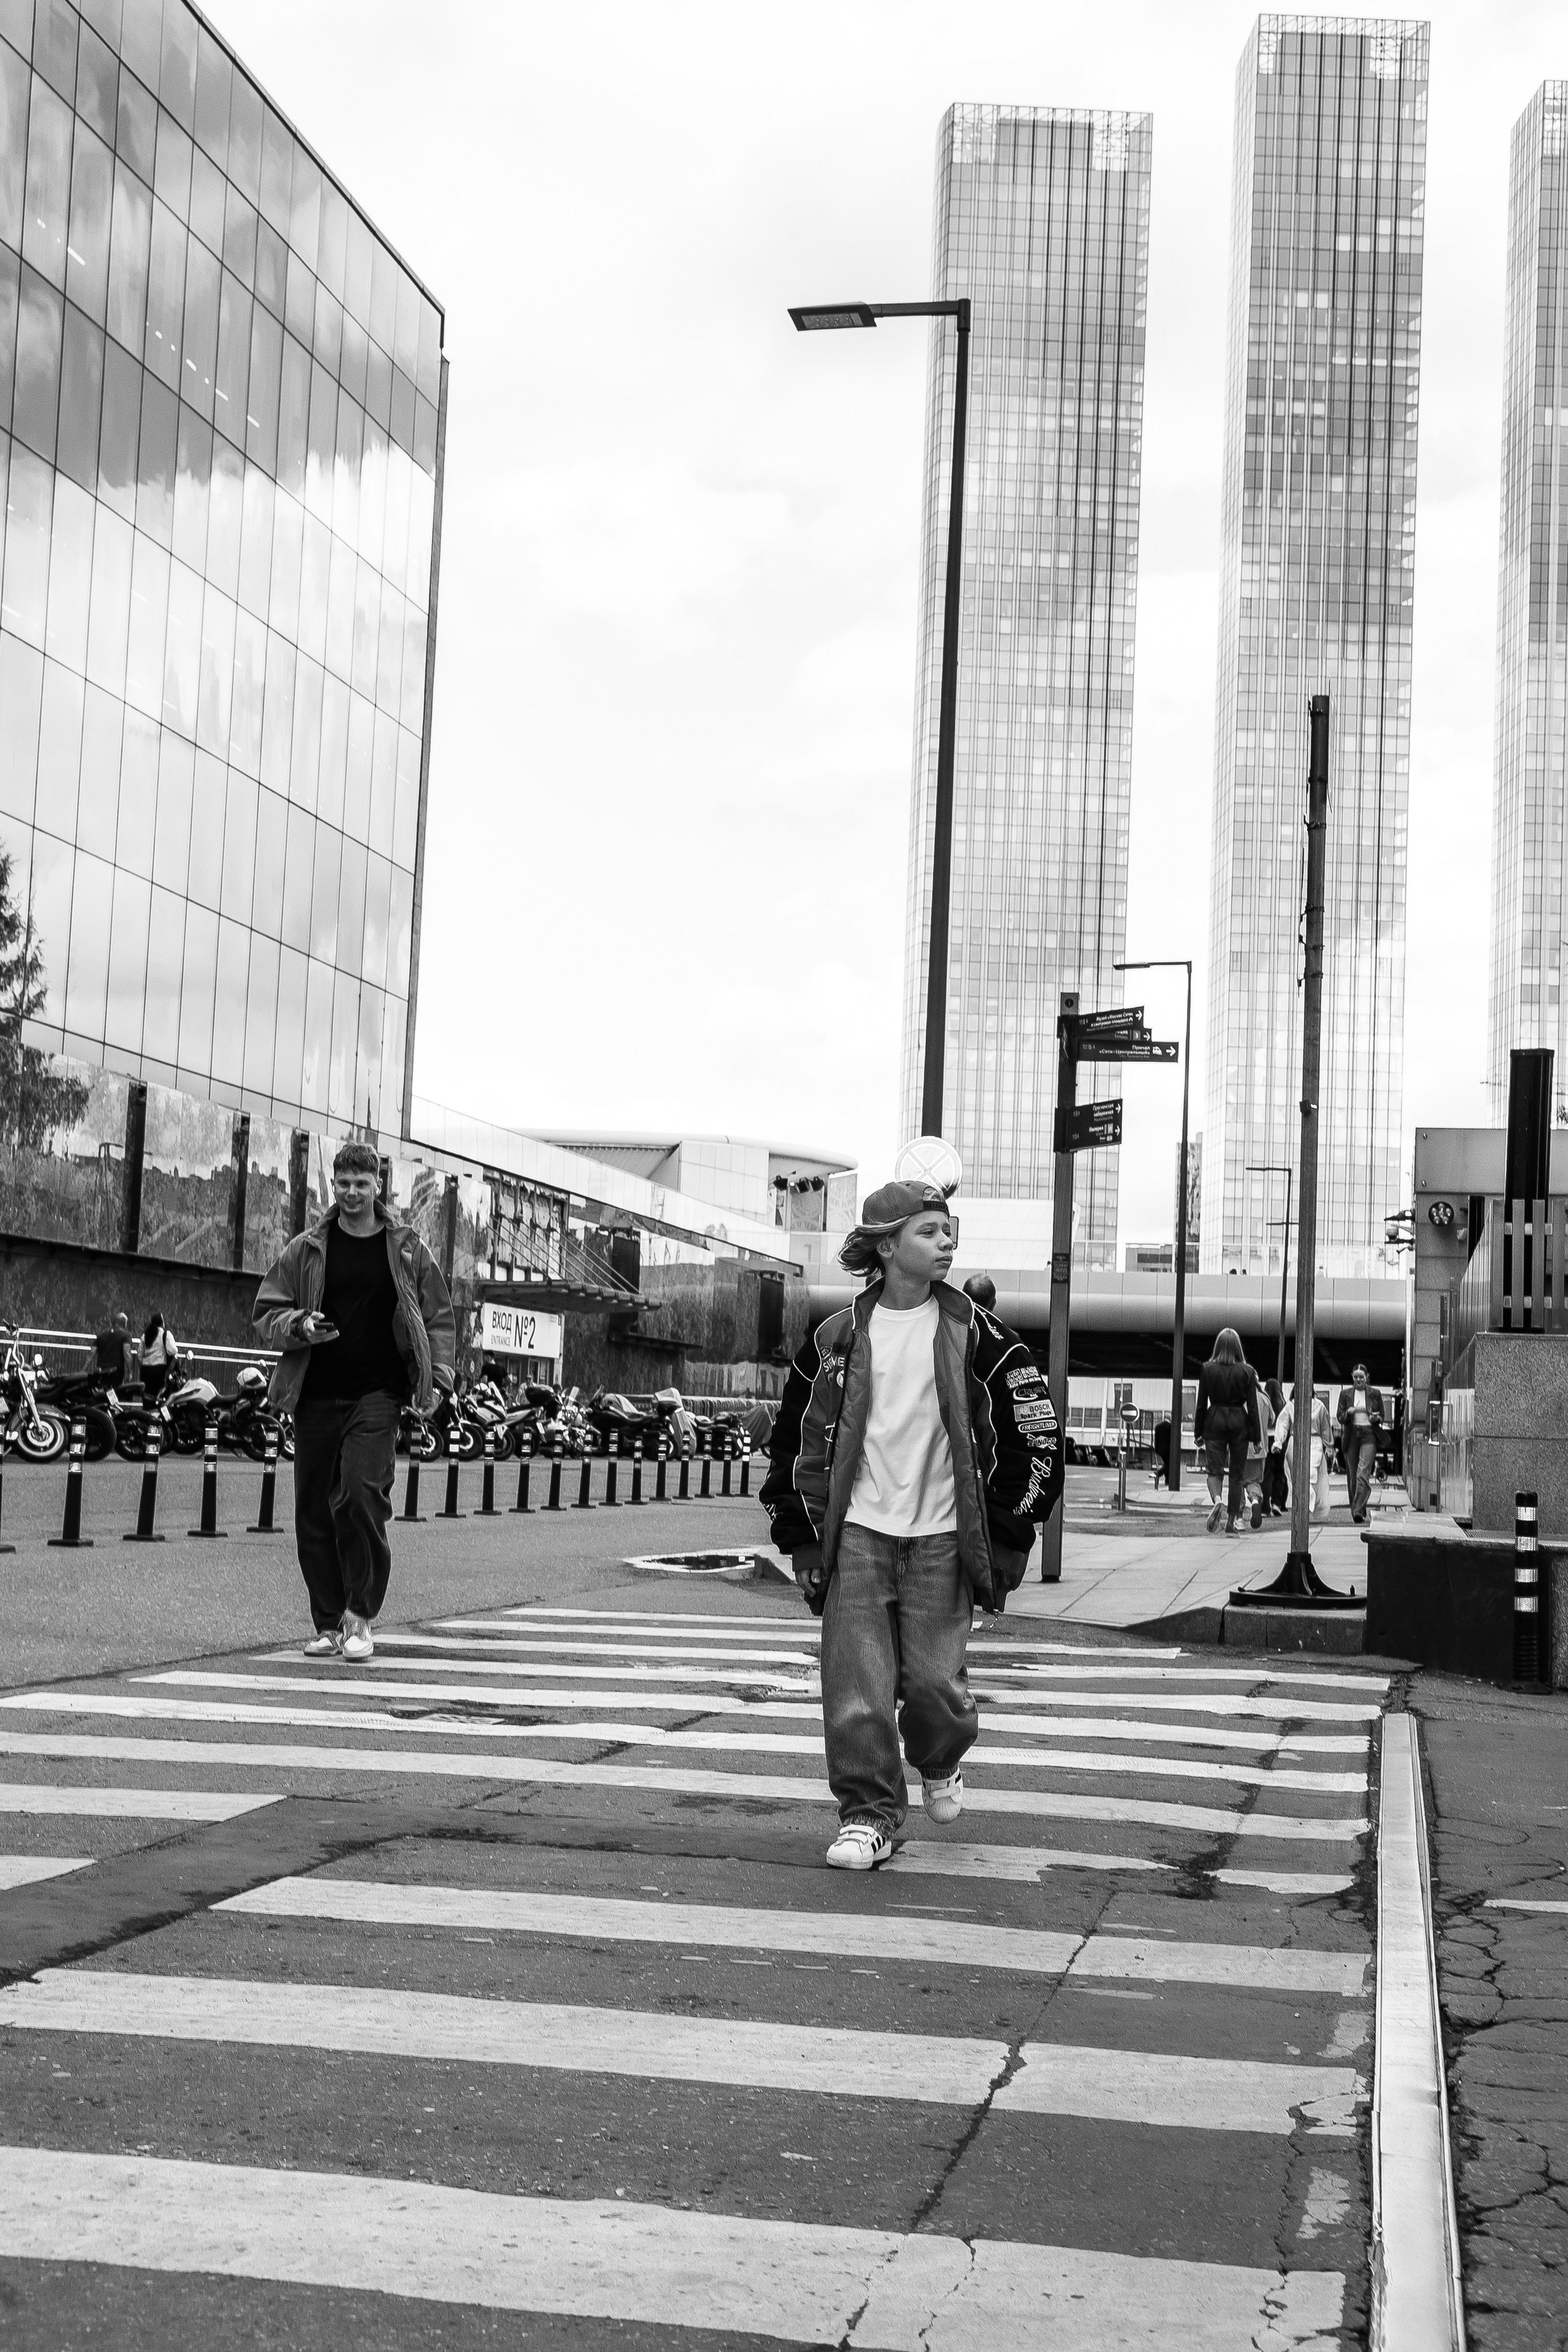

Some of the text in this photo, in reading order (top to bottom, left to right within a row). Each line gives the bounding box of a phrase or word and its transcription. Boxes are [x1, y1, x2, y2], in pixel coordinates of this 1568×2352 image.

[492, 1311, 511, 1335] ВХОД
[491, 1335, 510, 1347] ENTRANCE
[1030, 1403, 1050, 1412] BOSCH
[1022, 1422, 1055, 1431] FREIGHTLINER
[1027, 1437, 1057, 1447] SUNOCO
